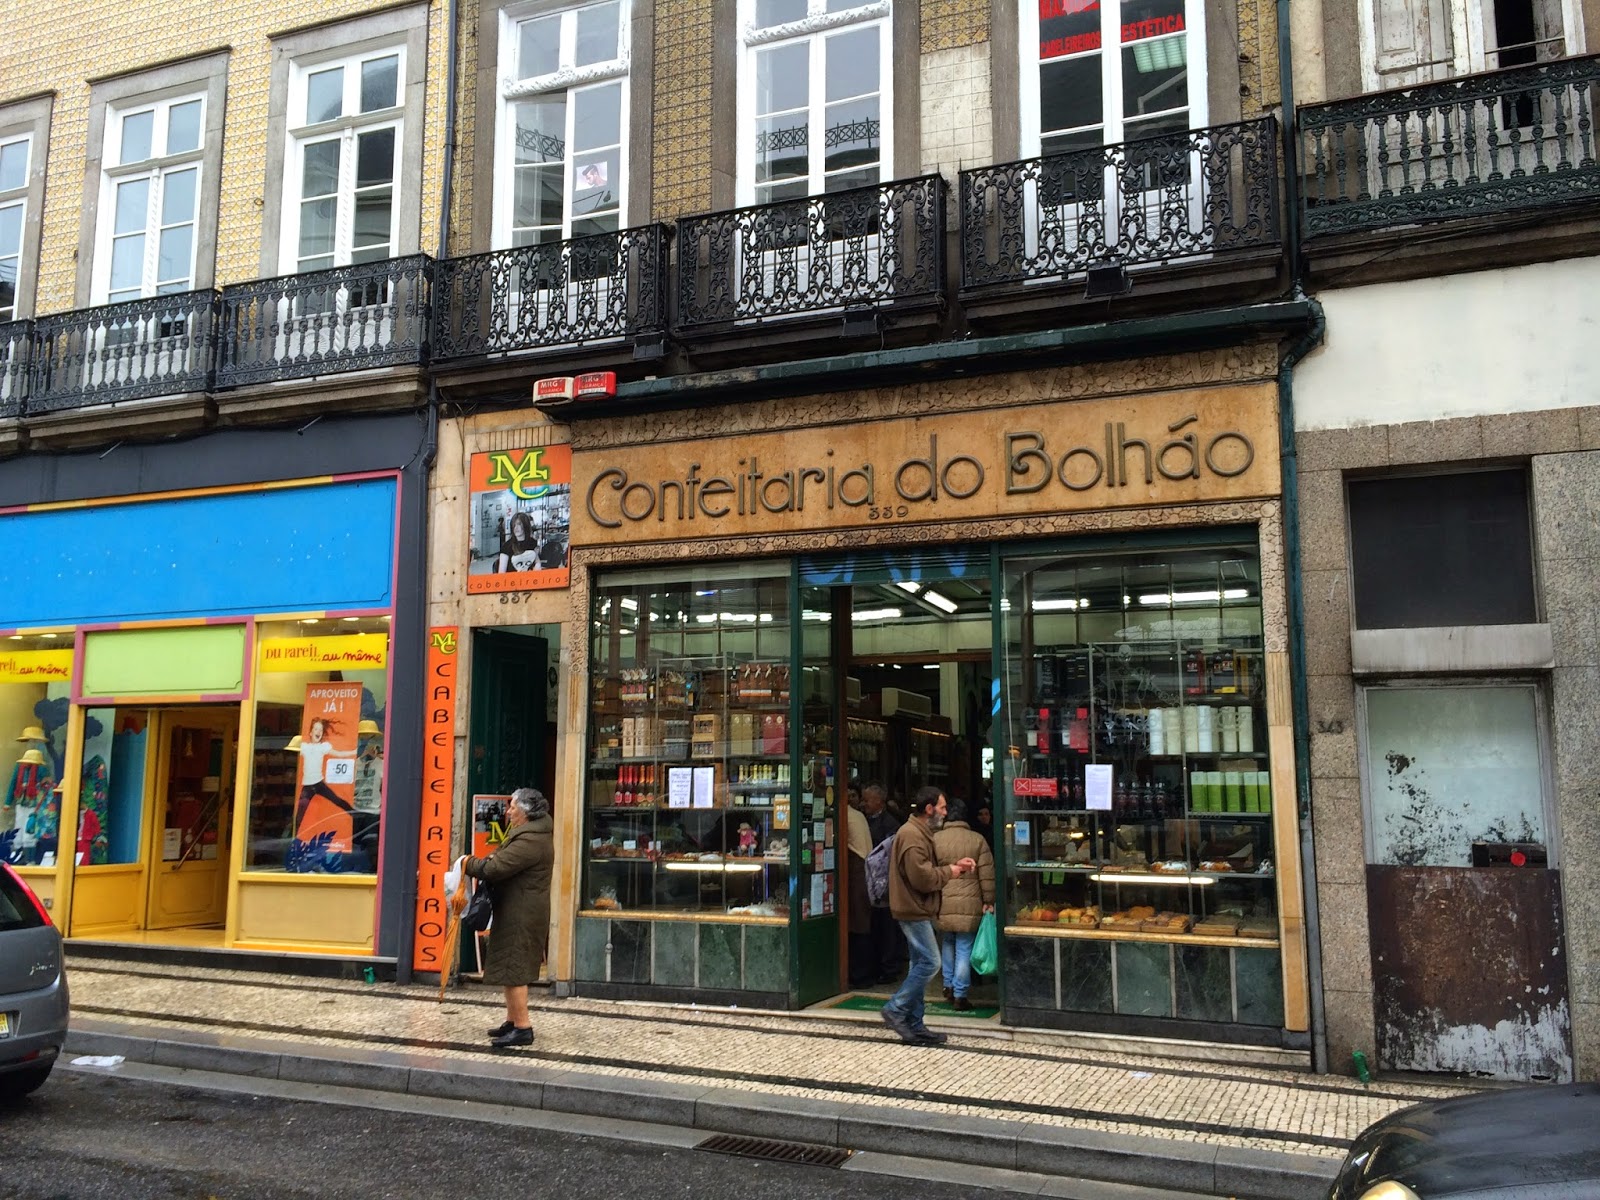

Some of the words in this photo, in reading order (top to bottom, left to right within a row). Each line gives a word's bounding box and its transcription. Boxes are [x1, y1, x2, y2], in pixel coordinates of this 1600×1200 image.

[1121, 13, 1184, 42] ESTÉTICA
[489, 450, 549, 500] MC
[586, 448, 875, 528] Confeitaria
[895, 432, 985, 500] do
[469, 576, 570, 590] cabeleireiros
[499, 591, 533, 604] 337
[432, 632, 456, 655] MC
[342, 649, 382, 663] même
[310, 688, 358, 698] APROVEITO
[323, 698, 337, 713] JÁ
[419, 662, 452, 963] CABELEIREIROS
[488, 821, 512, 845] M
